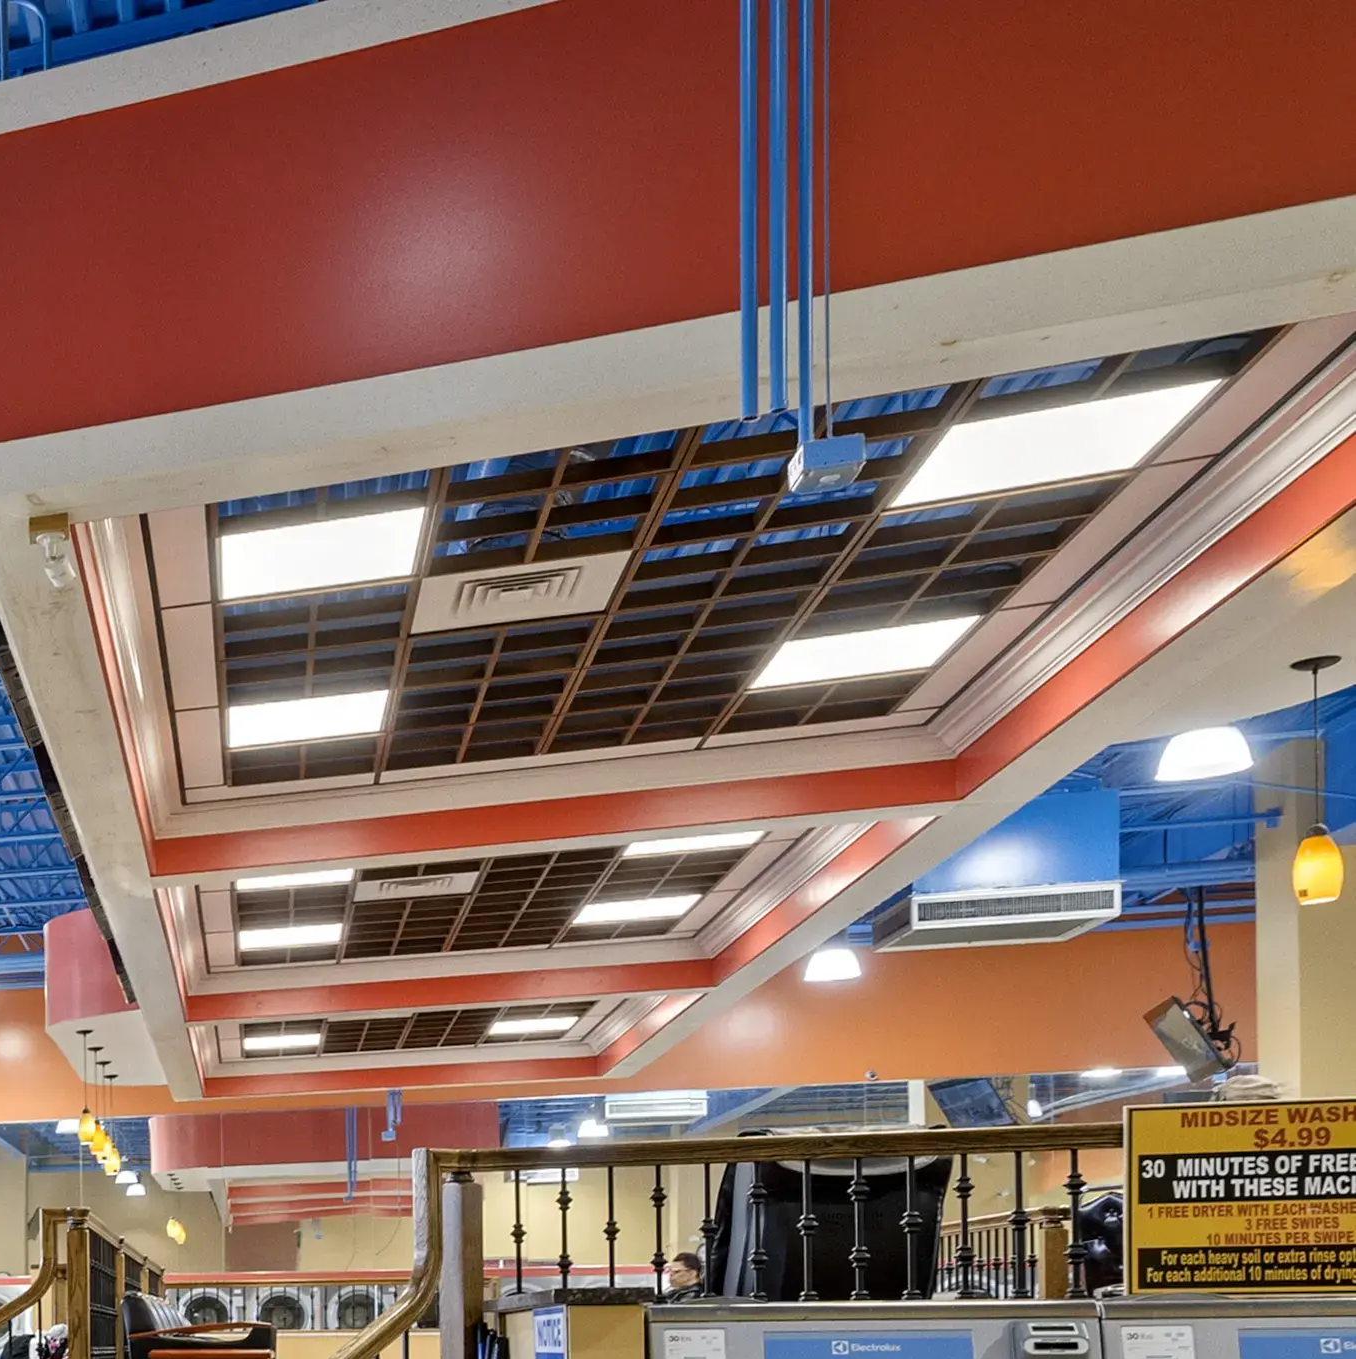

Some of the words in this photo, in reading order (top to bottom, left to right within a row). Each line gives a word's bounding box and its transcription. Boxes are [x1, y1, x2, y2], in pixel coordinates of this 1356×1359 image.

[1181, 1109, 1279, 1128] MIDSIZE
[1287, 1105, 1356, 1124] WASH
[1253, 1126, 1331, 1149] $4.99
[1141, 1159, 1166, 1179] 30
[1176, 1156, 1270, 1177] MINUTES
[1274, 1155, 1303, 1175] OF
[1309, 1153, 1356, 1173] FREE
[1172, 1179, 1225, 1199] WITH
[1230, 1177, 1298, 1197] THESE
[1148, 1207, 1153, 1219] 1
[1158, 1206, 1189, 1218] FREE
[1193, 1204, 1233, 1217] DRYER
[1237, 1203, 1269, 1217] WITH
[1274, 1203, 1306, 1216] EACH
[1245, 1218, 1253, 1230] 3
[1256, 1217, 1287, 1230] FREE
[1291, 1216, 1340, 1229] SWIPES
[1206, 1233, 1221, 1246] 10
[1225, 1232, 1281, 1245] MINUTES
[1285, 1231, 1309, 1244] PER
[1314, 1230, 1354, 1243] SWIPE
[1161, 1250, 1178, 1266] For
[1180, 1250, 1206, 1265] each
[1208, 1249, 1240, 1269] heavy
[1241, 1248, 1261, 1264] soil
[1263, 1251, 1276, 1264] or
[1277, 1248, 1306, 1263] extra
[1309, 1247, 1337, 1263] rinse
[1147, 1267, 1163, 1283] For
[1165, 1267, 1191, 1283] each
[1193, 1266, 1246, 1282] additional
[1248, 1266, 1262, 1281] 10
[1264, 1265, 1308, 1281] minutes
[1310, 1264, 1322, 1280] of
[537, 1317, 562, 1347] NOTICE
[668, 1335, 680, 1343] 30
[1127, 1332, 1139, 1341] 30
[850, 1343, 901, 1352] Electrolux
